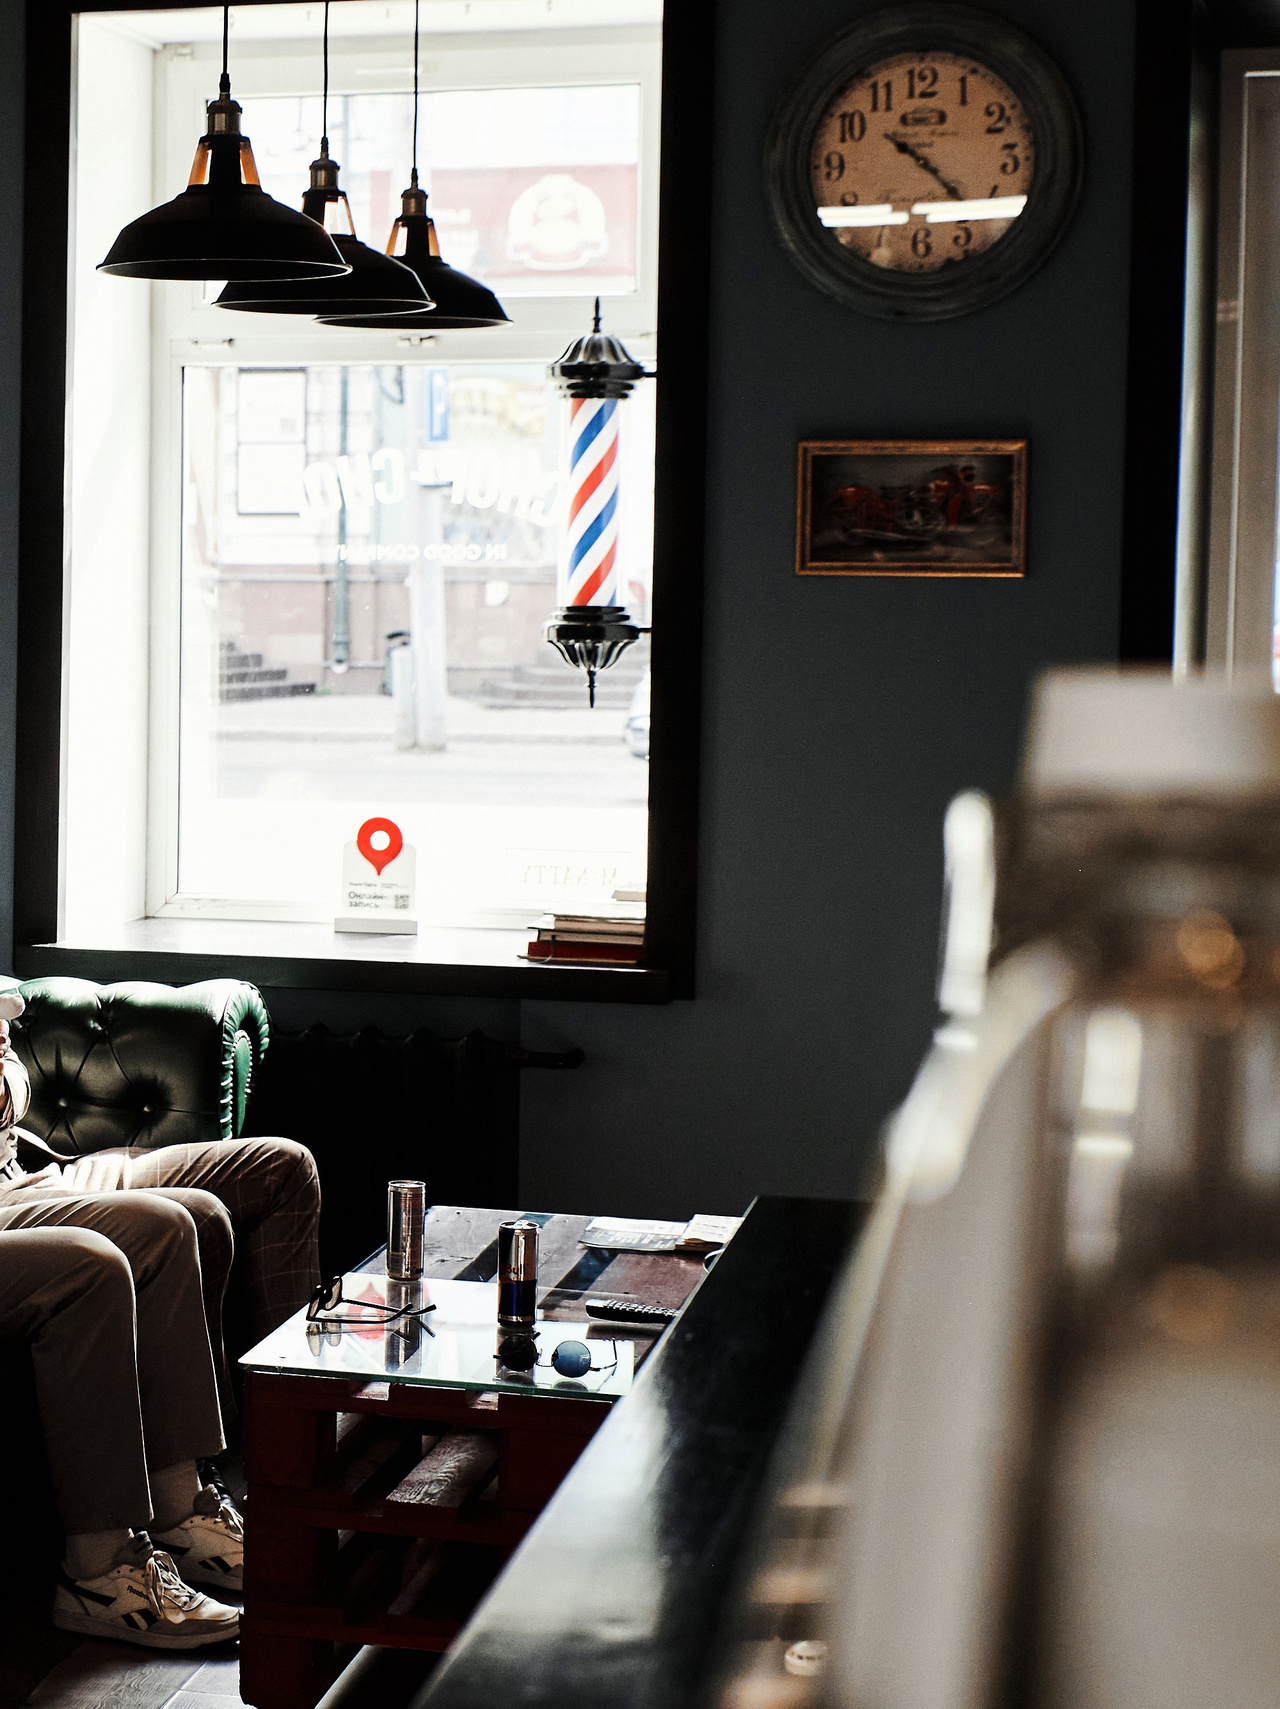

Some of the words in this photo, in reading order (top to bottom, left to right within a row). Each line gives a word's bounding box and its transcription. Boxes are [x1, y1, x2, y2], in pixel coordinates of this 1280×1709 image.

[870, 80, 893, 112] 11
[907, 66, 939, 99] 12
[959, 75, 968, 106] 1
[839, 110, 867, 143] 10
[985, 102, 1007, 134] 2
[825, 151, 846, 182] 9
[1000, 143, 1020, 175] 3
[911, 227, 932, 258] 6
[348, 901, 380, 909] запись
